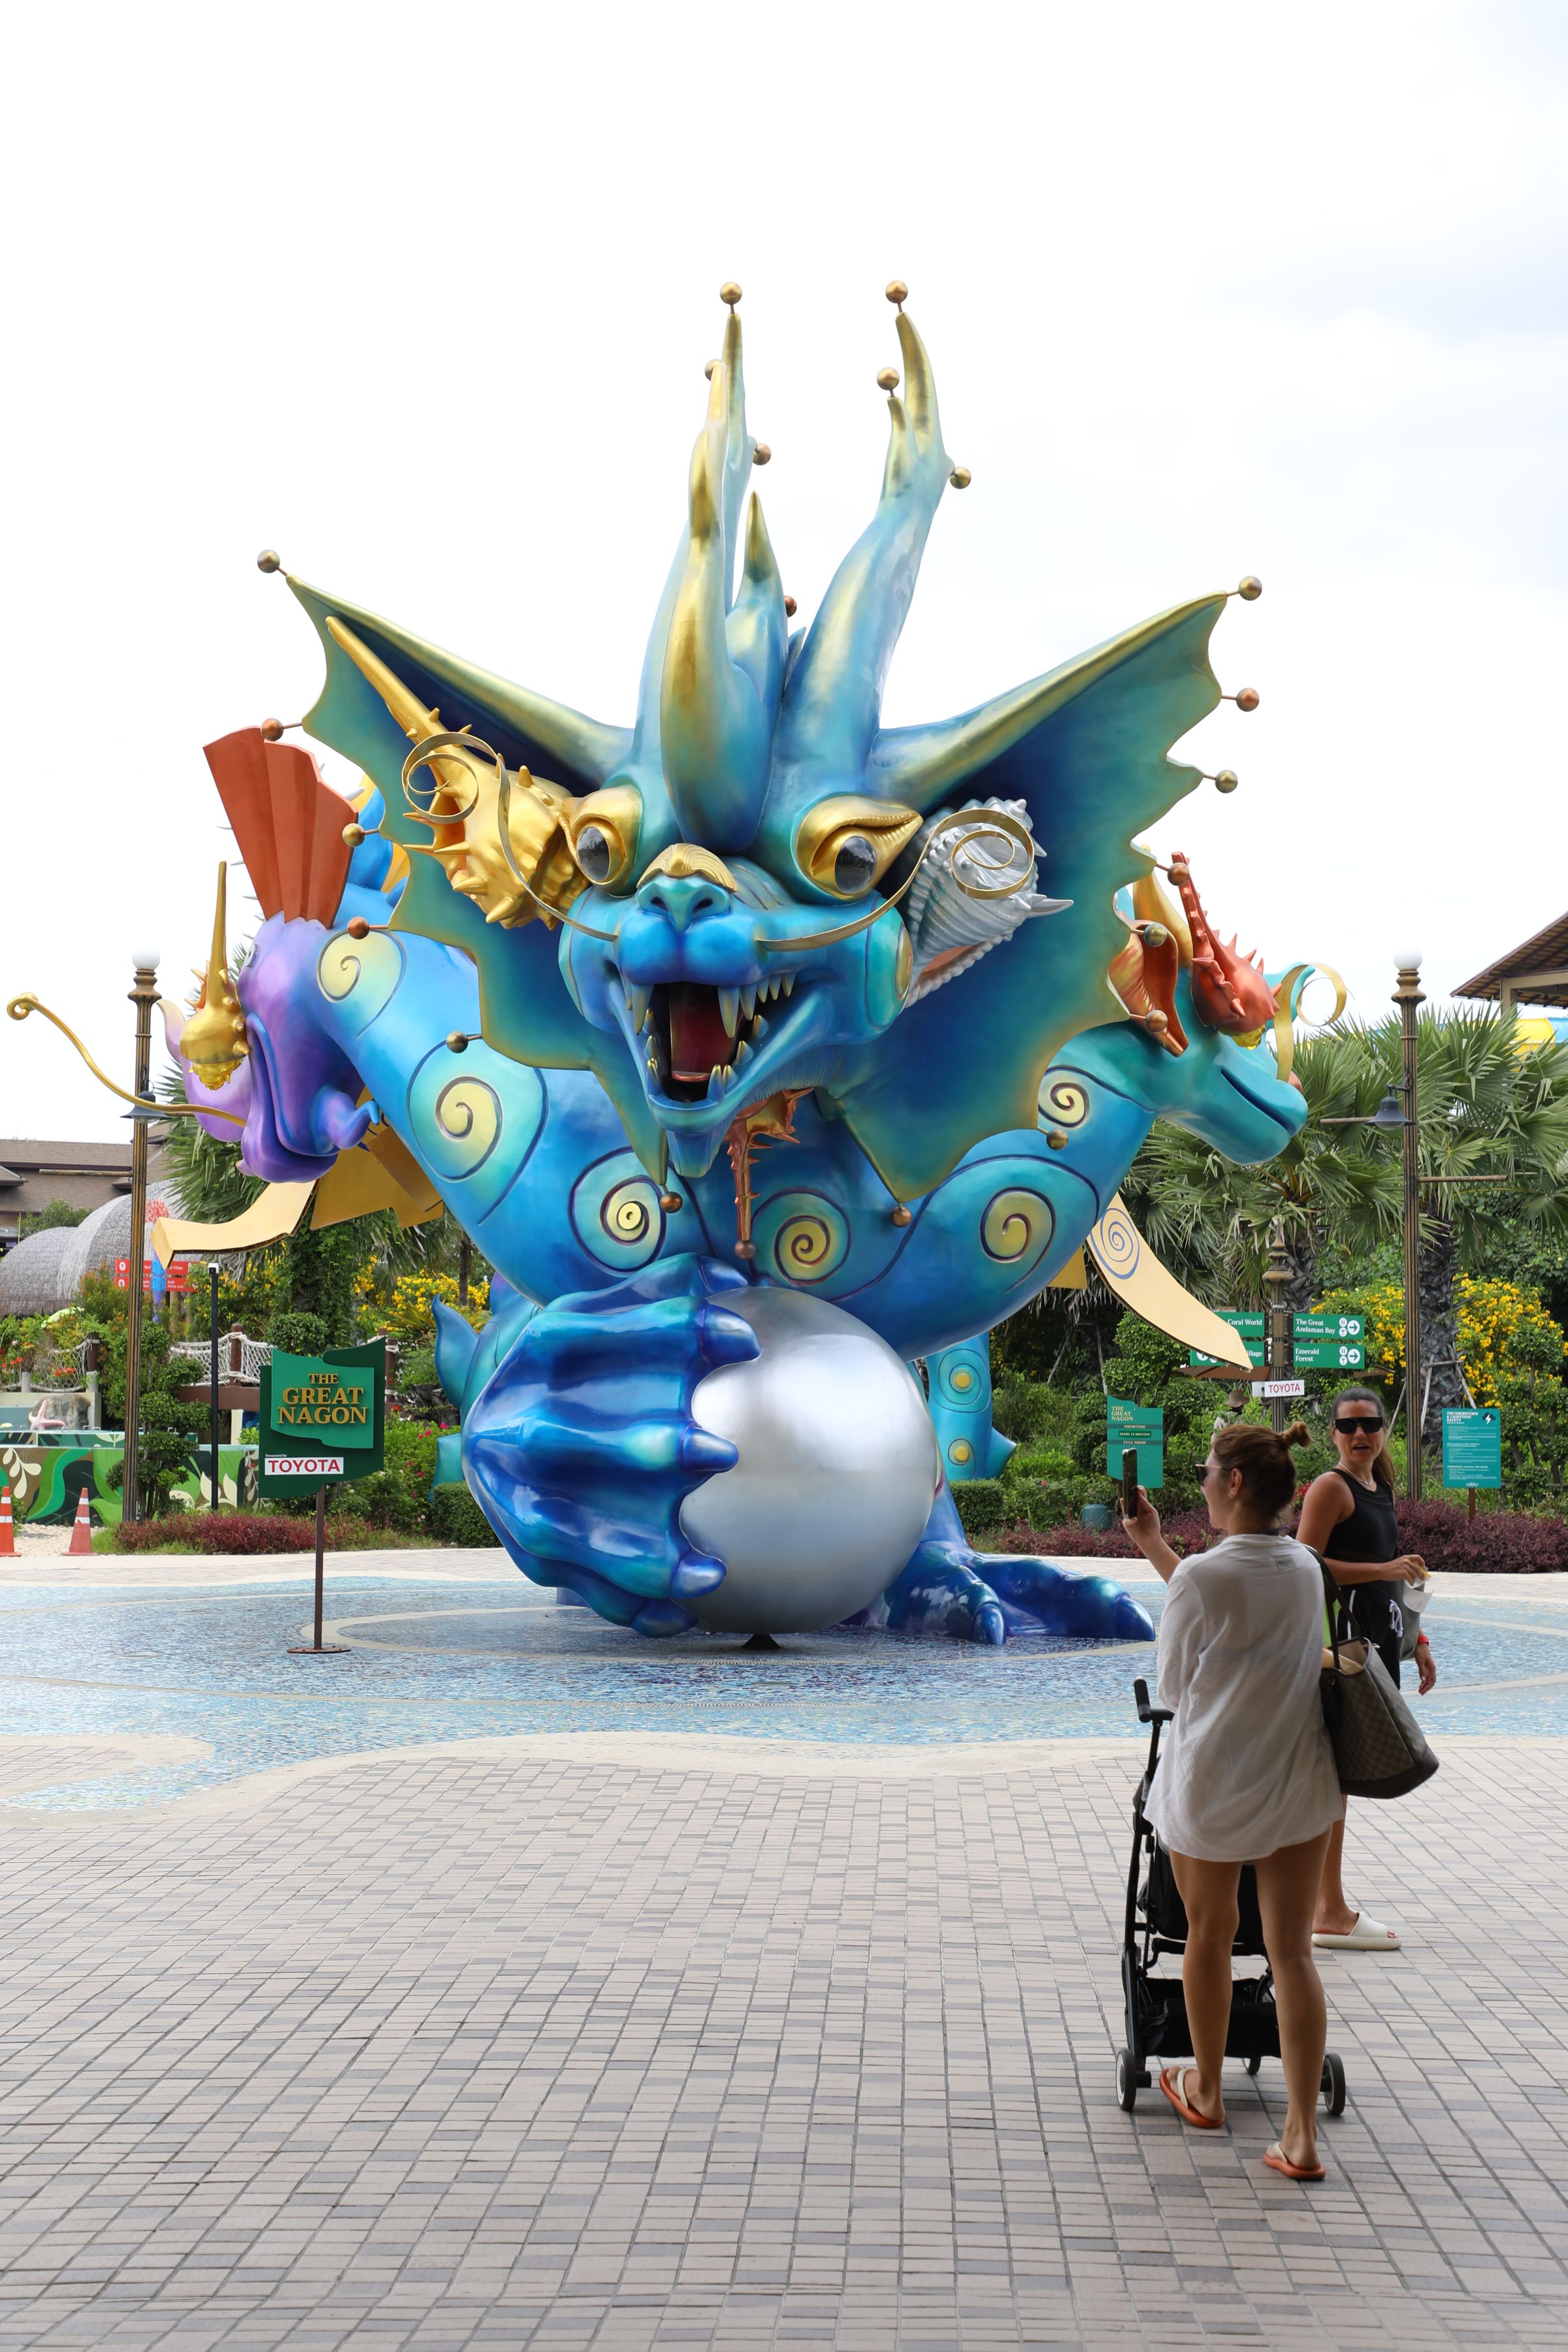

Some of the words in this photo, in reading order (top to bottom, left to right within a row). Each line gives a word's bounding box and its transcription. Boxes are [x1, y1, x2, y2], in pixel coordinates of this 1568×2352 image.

[308, 1373, 338, 1384] THE
[1268, 1383, 1300, 1394] TOYOTA
[282, 1387, 363, 1405] GREAT
[278, 1407, 367, 1424] NAGON
[268, 1459, 340, 1473] TOYOTA
